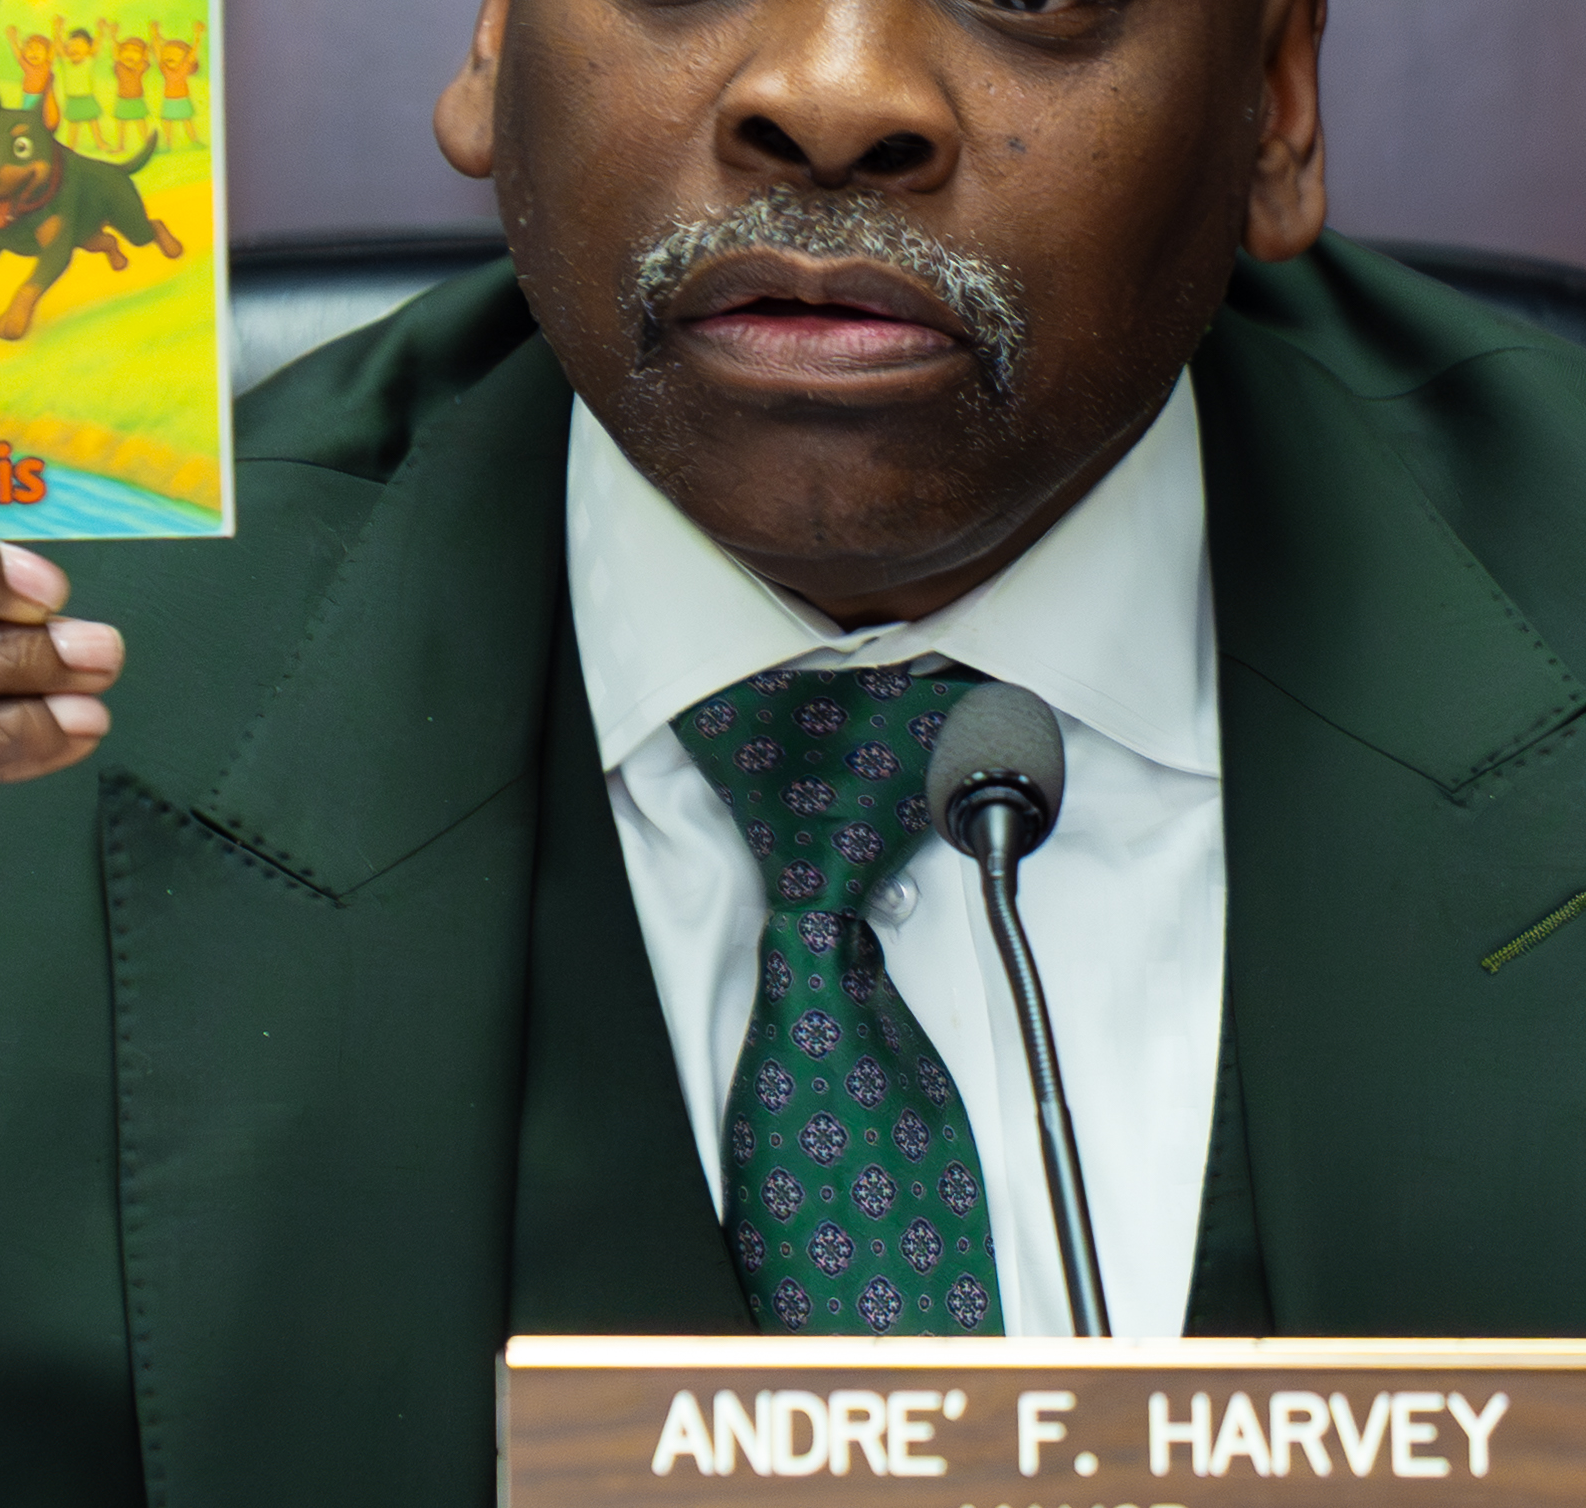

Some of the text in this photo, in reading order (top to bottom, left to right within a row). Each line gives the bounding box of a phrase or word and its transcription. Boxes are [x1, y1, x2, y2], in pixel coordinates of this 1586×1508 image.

[650, 1388, 1511, 1478] ANDRE' F. HARVEY
